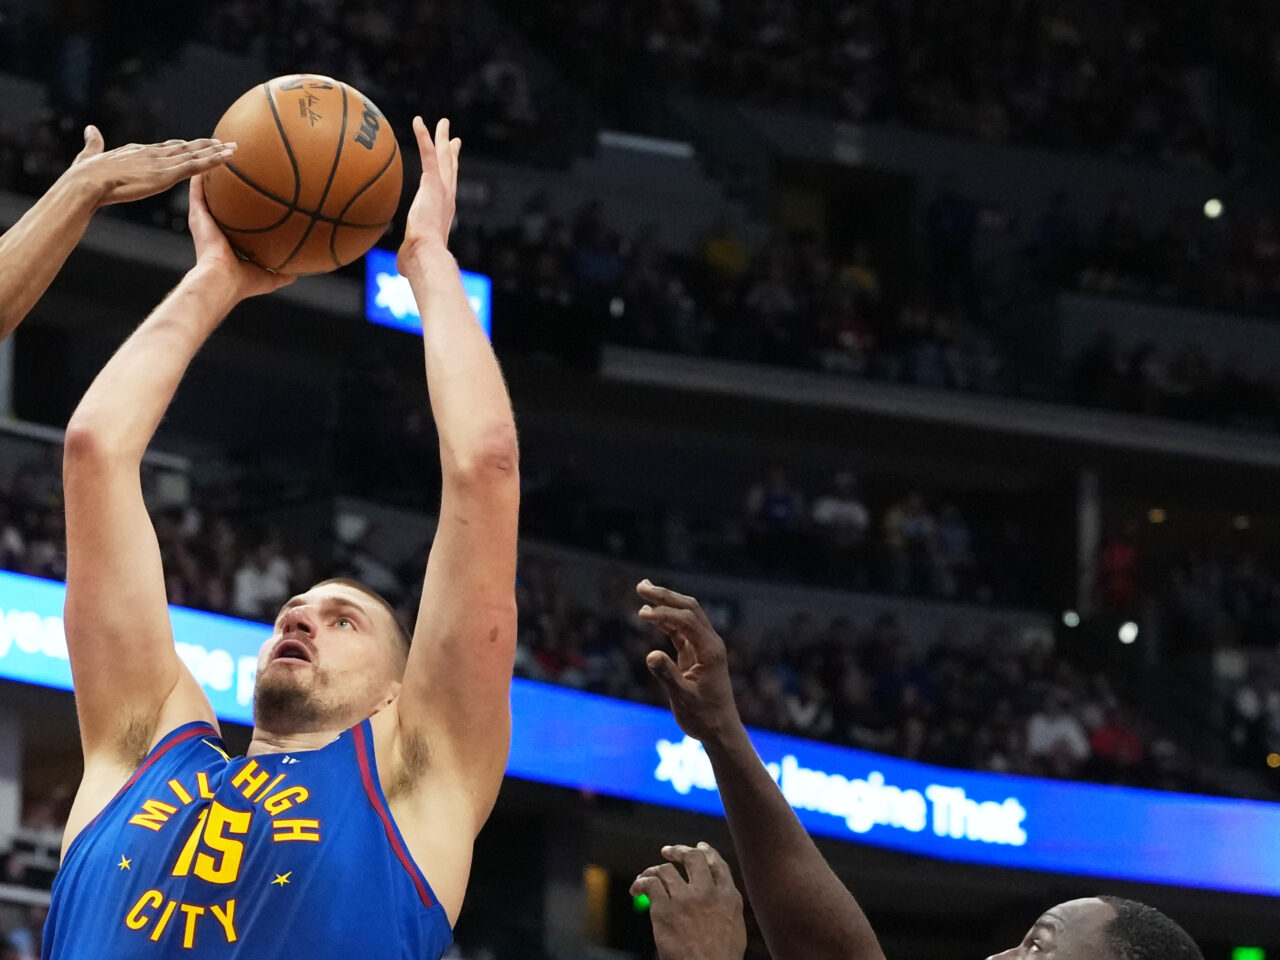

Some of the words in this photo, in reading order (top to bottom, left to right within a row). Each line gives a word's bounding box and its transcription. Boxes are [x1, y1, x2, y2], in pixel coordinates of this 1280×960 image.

[171, 800, 253, 884] 15
[231, 759, 320, 842] HIGH
[781, 755, 927, 833] Imagine
[926, 784, 1027, 846] That
[125, 889, 238, 949] CITY
